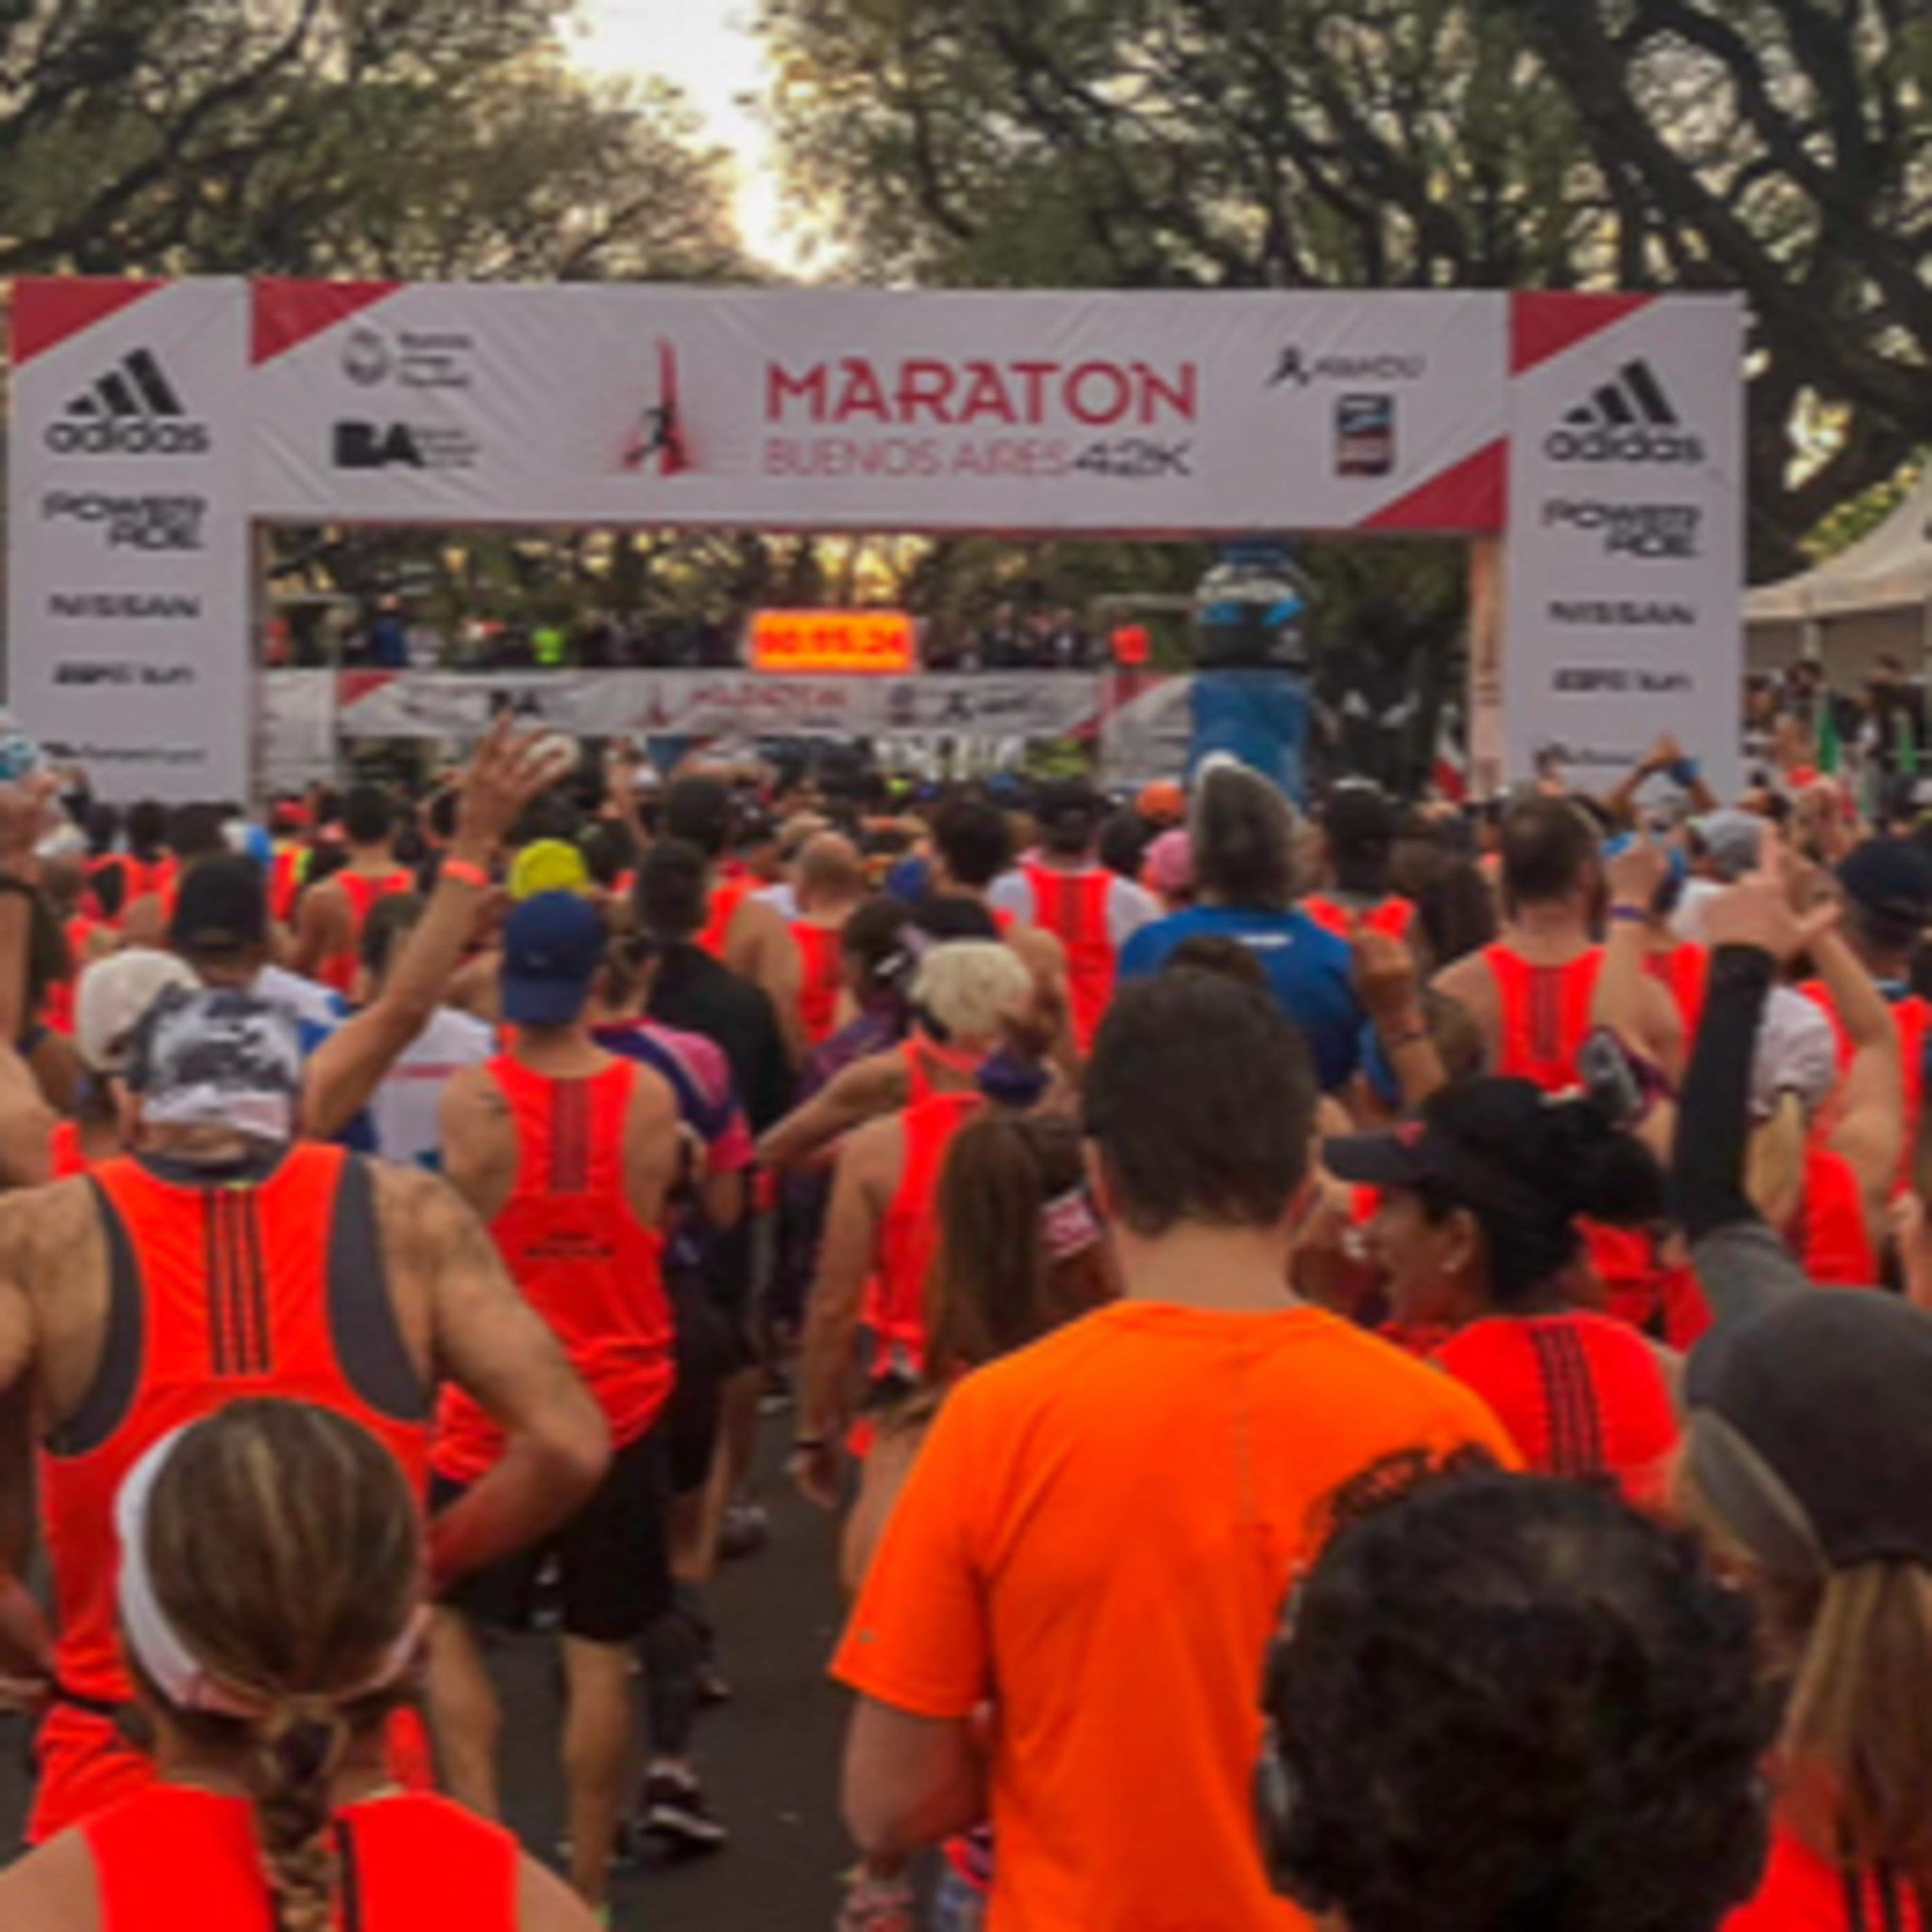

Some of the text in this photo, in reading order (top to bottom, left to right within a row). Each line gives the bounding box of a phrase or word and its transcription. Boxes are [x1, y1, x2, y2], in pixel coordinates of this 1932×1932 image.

[765, 357, 1197, 426] MARATON
[44, 421, 210, 455] adidas
[334, 422, 424, 468] BA
[1545, 428, 1705, 464] adidas
[764, 437, 1192, 478] BUENOS AIRES 42K
[48, 594, 201, 619] NISSAN
[1548, 600, 1696, 626] NISSAN
